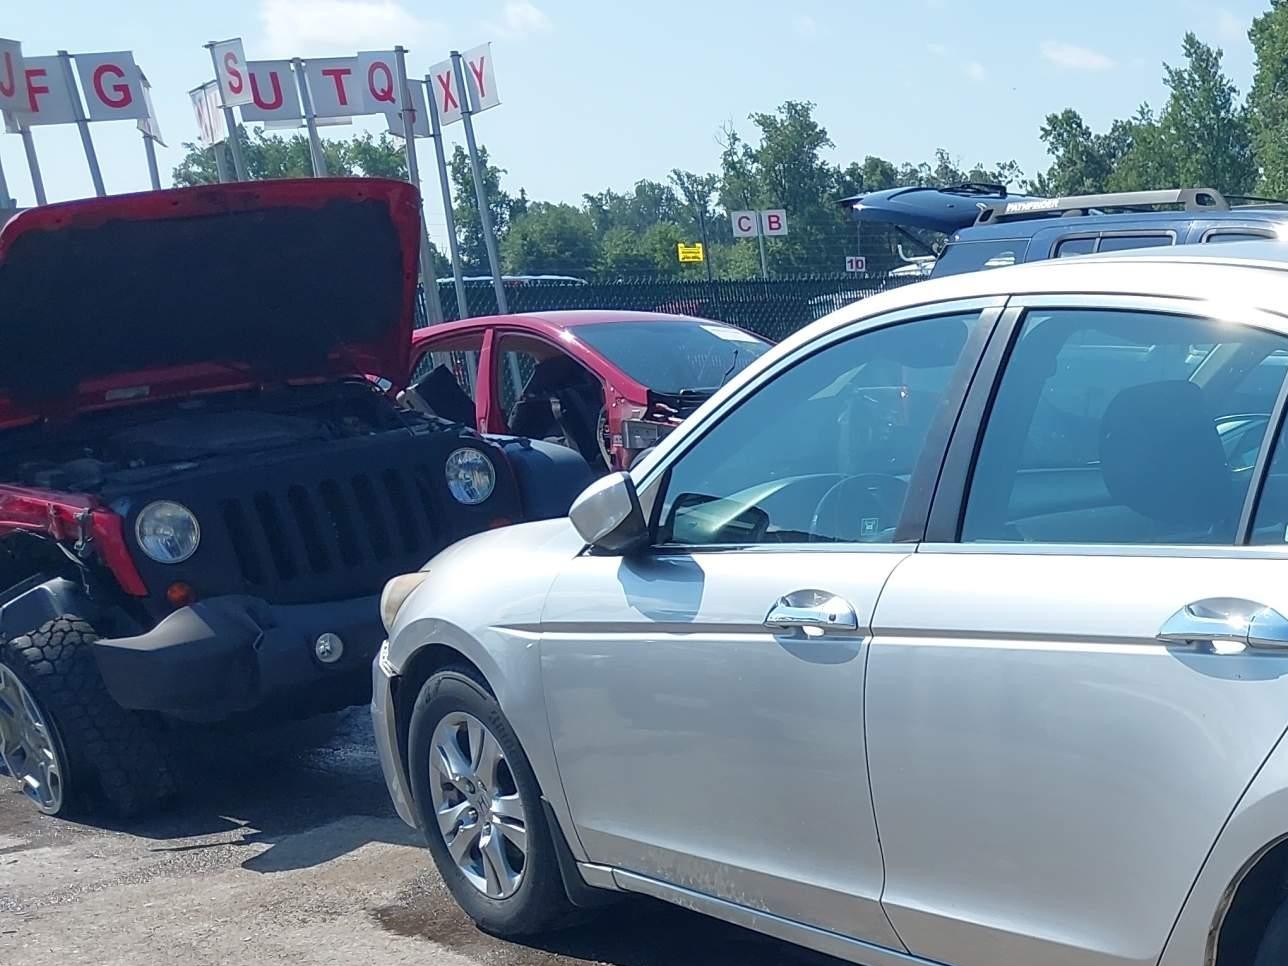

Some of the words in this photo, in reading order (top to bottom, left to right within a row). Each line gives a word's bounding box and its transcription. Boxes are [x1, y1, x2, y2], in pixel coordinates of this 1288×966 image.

[24, 68, 49, 113] F
[93, 63, 133, 109] G
[223, 52, 243, 94] S
[248, 71, 284, 110] U
[321, 68, 353, 106] T
[367, 61, 396, 104] Q
[437, 70, 458, 113] X
[469, 56, 485, 98] Y
[737, 215, 752, 233] C
[768, 214, 782, 231] B
[847, 259, 864, 270] 10
